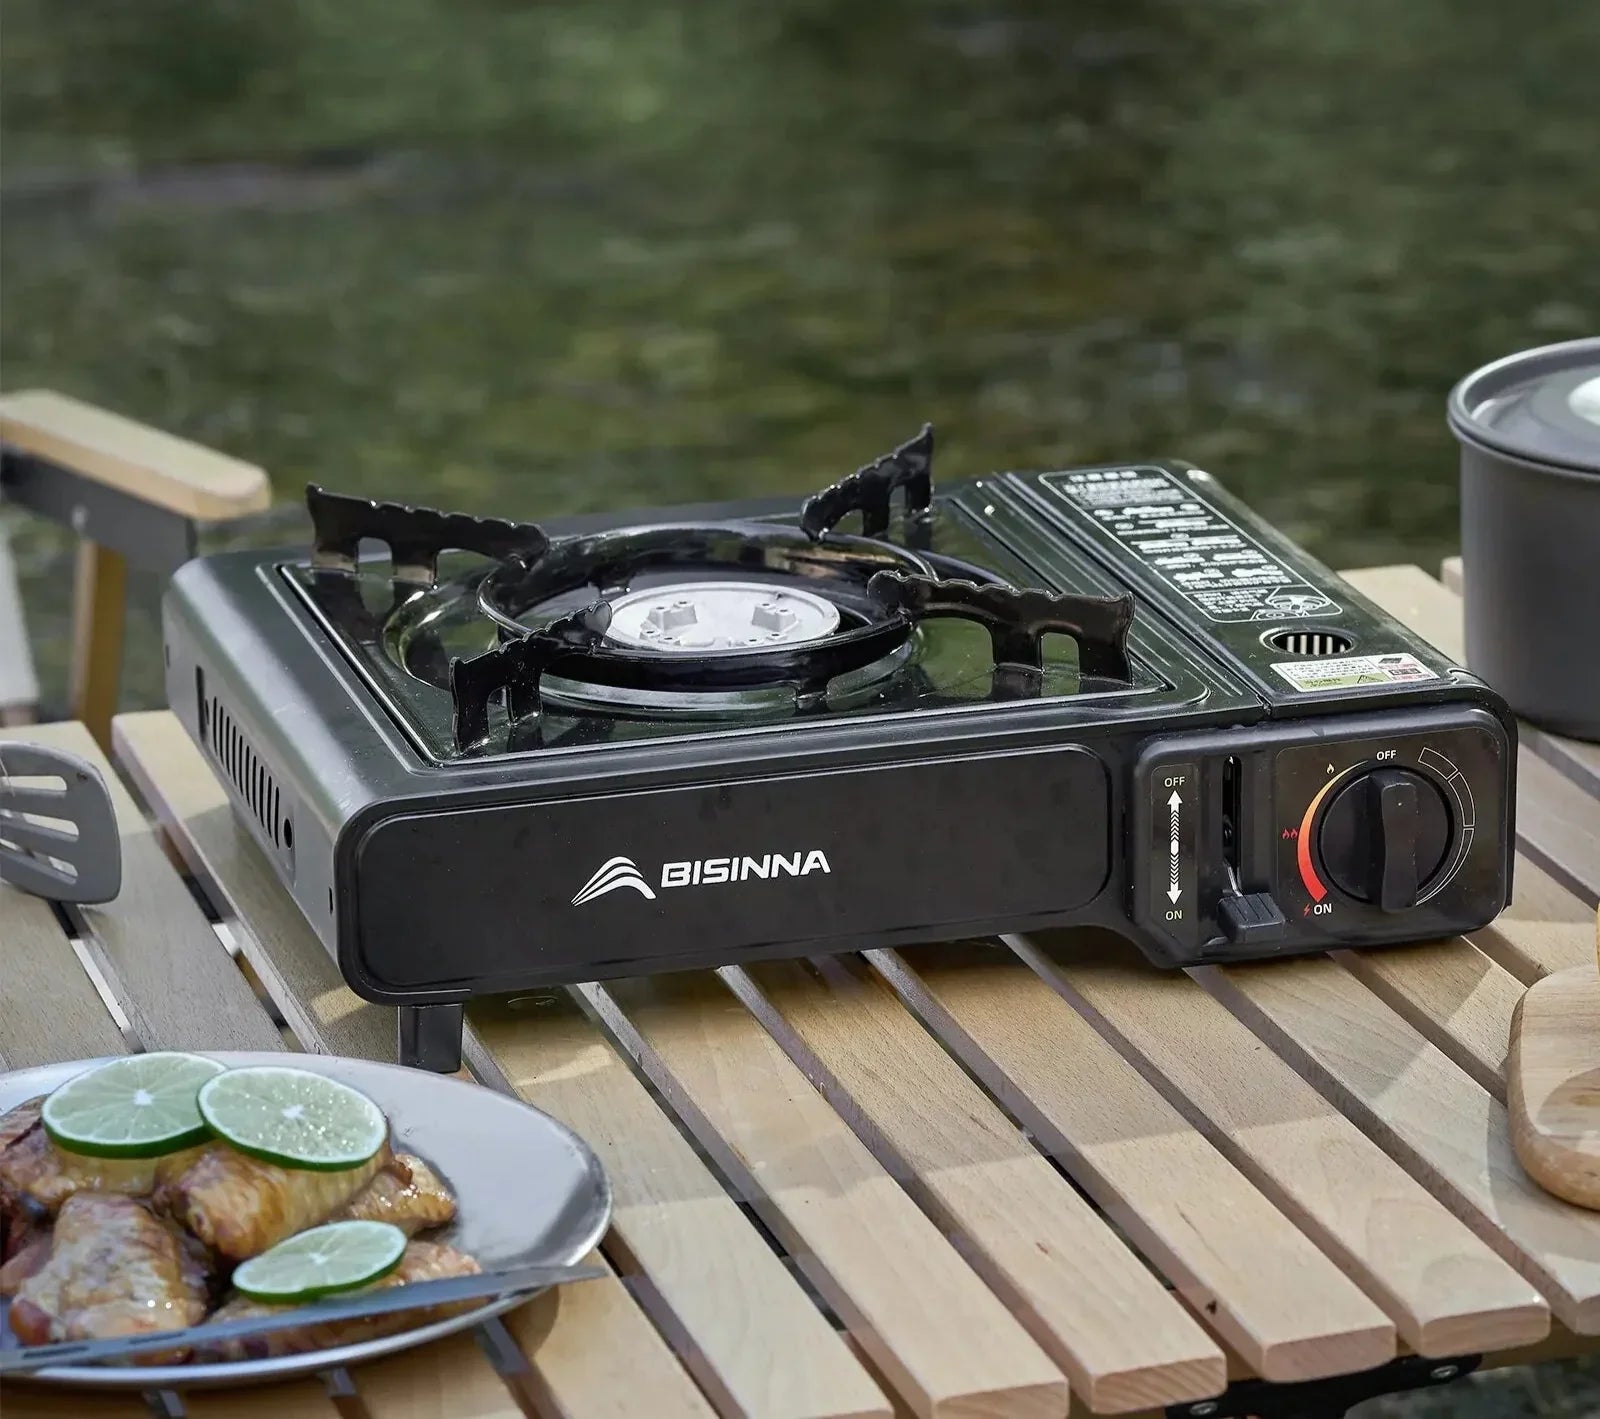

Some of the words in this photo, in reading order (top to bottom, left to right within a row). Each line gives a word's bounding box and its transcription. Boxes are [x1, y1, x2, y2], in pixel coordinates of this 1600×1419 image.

[1376, 749, 1397, 761] OFF
[1164, 776, 1185, 788] OFF
[660, 850, 831, 888] BISINNA
[1313, 902, 1332, 915] ON
[1165, 909, 1183, 921] ON
